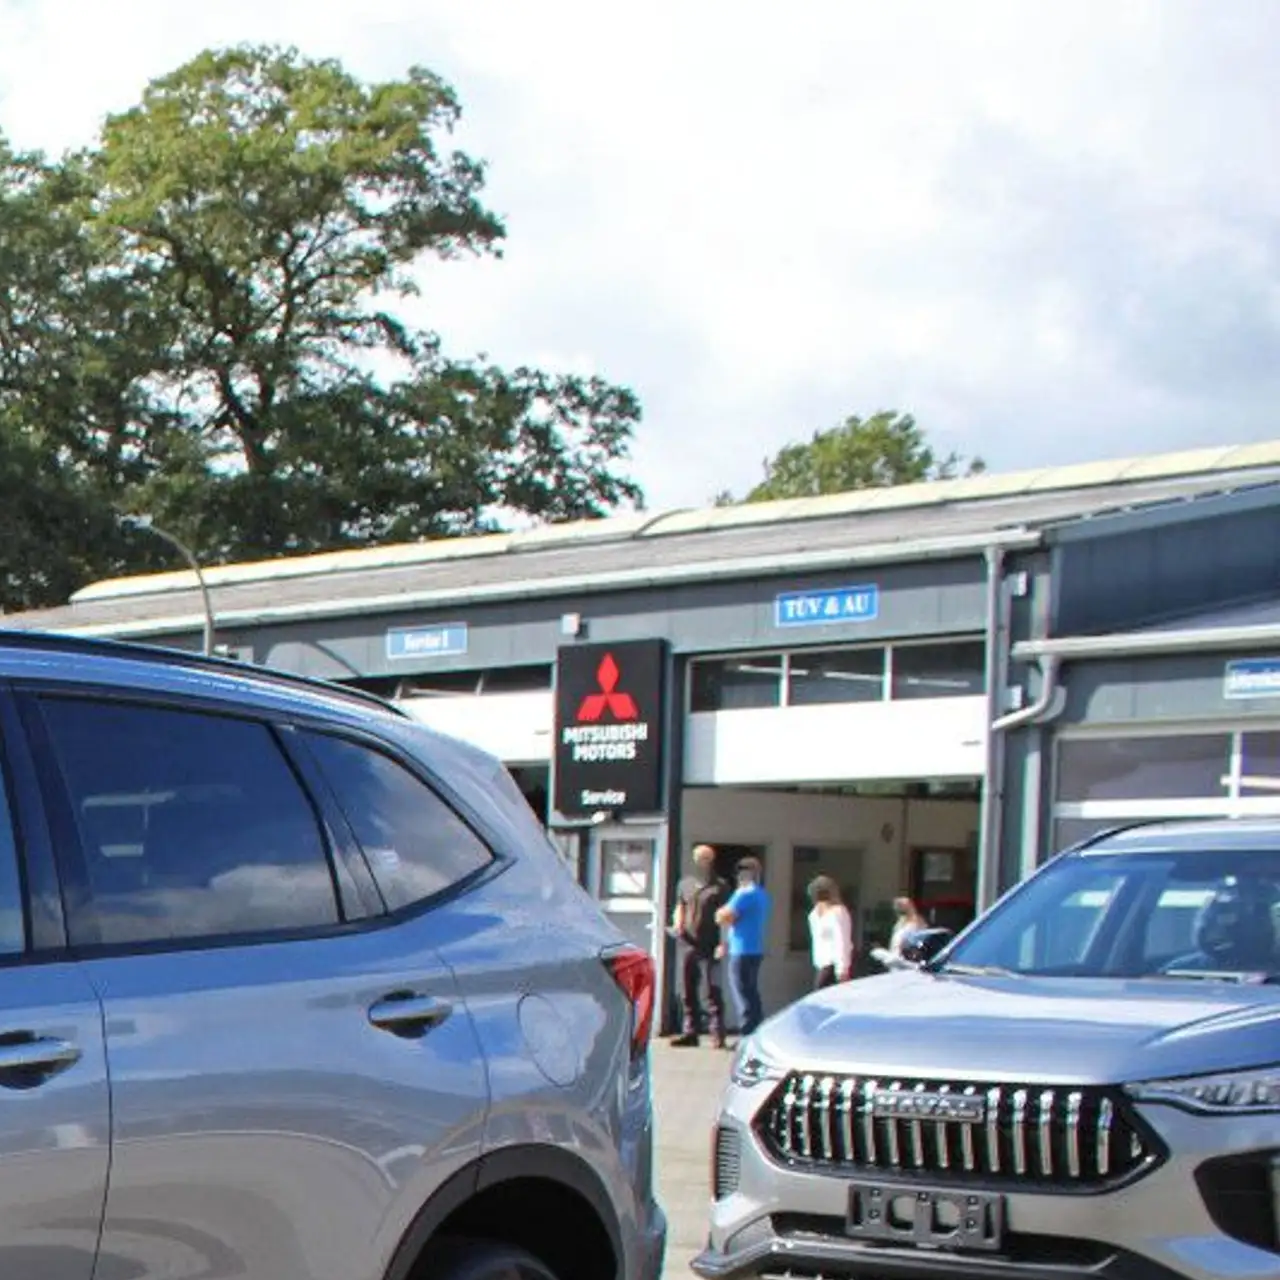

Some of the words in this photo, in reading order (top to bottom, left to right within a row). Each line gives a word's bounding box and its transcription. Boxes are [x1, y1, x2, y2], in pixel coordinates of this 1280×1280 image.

[844, 592, 871, 613] AU
[563, 723, 648, 744] MITSUBISHI
[573, 742, 636, 760] MOTORS
[581, 789, 626, 805] Service
